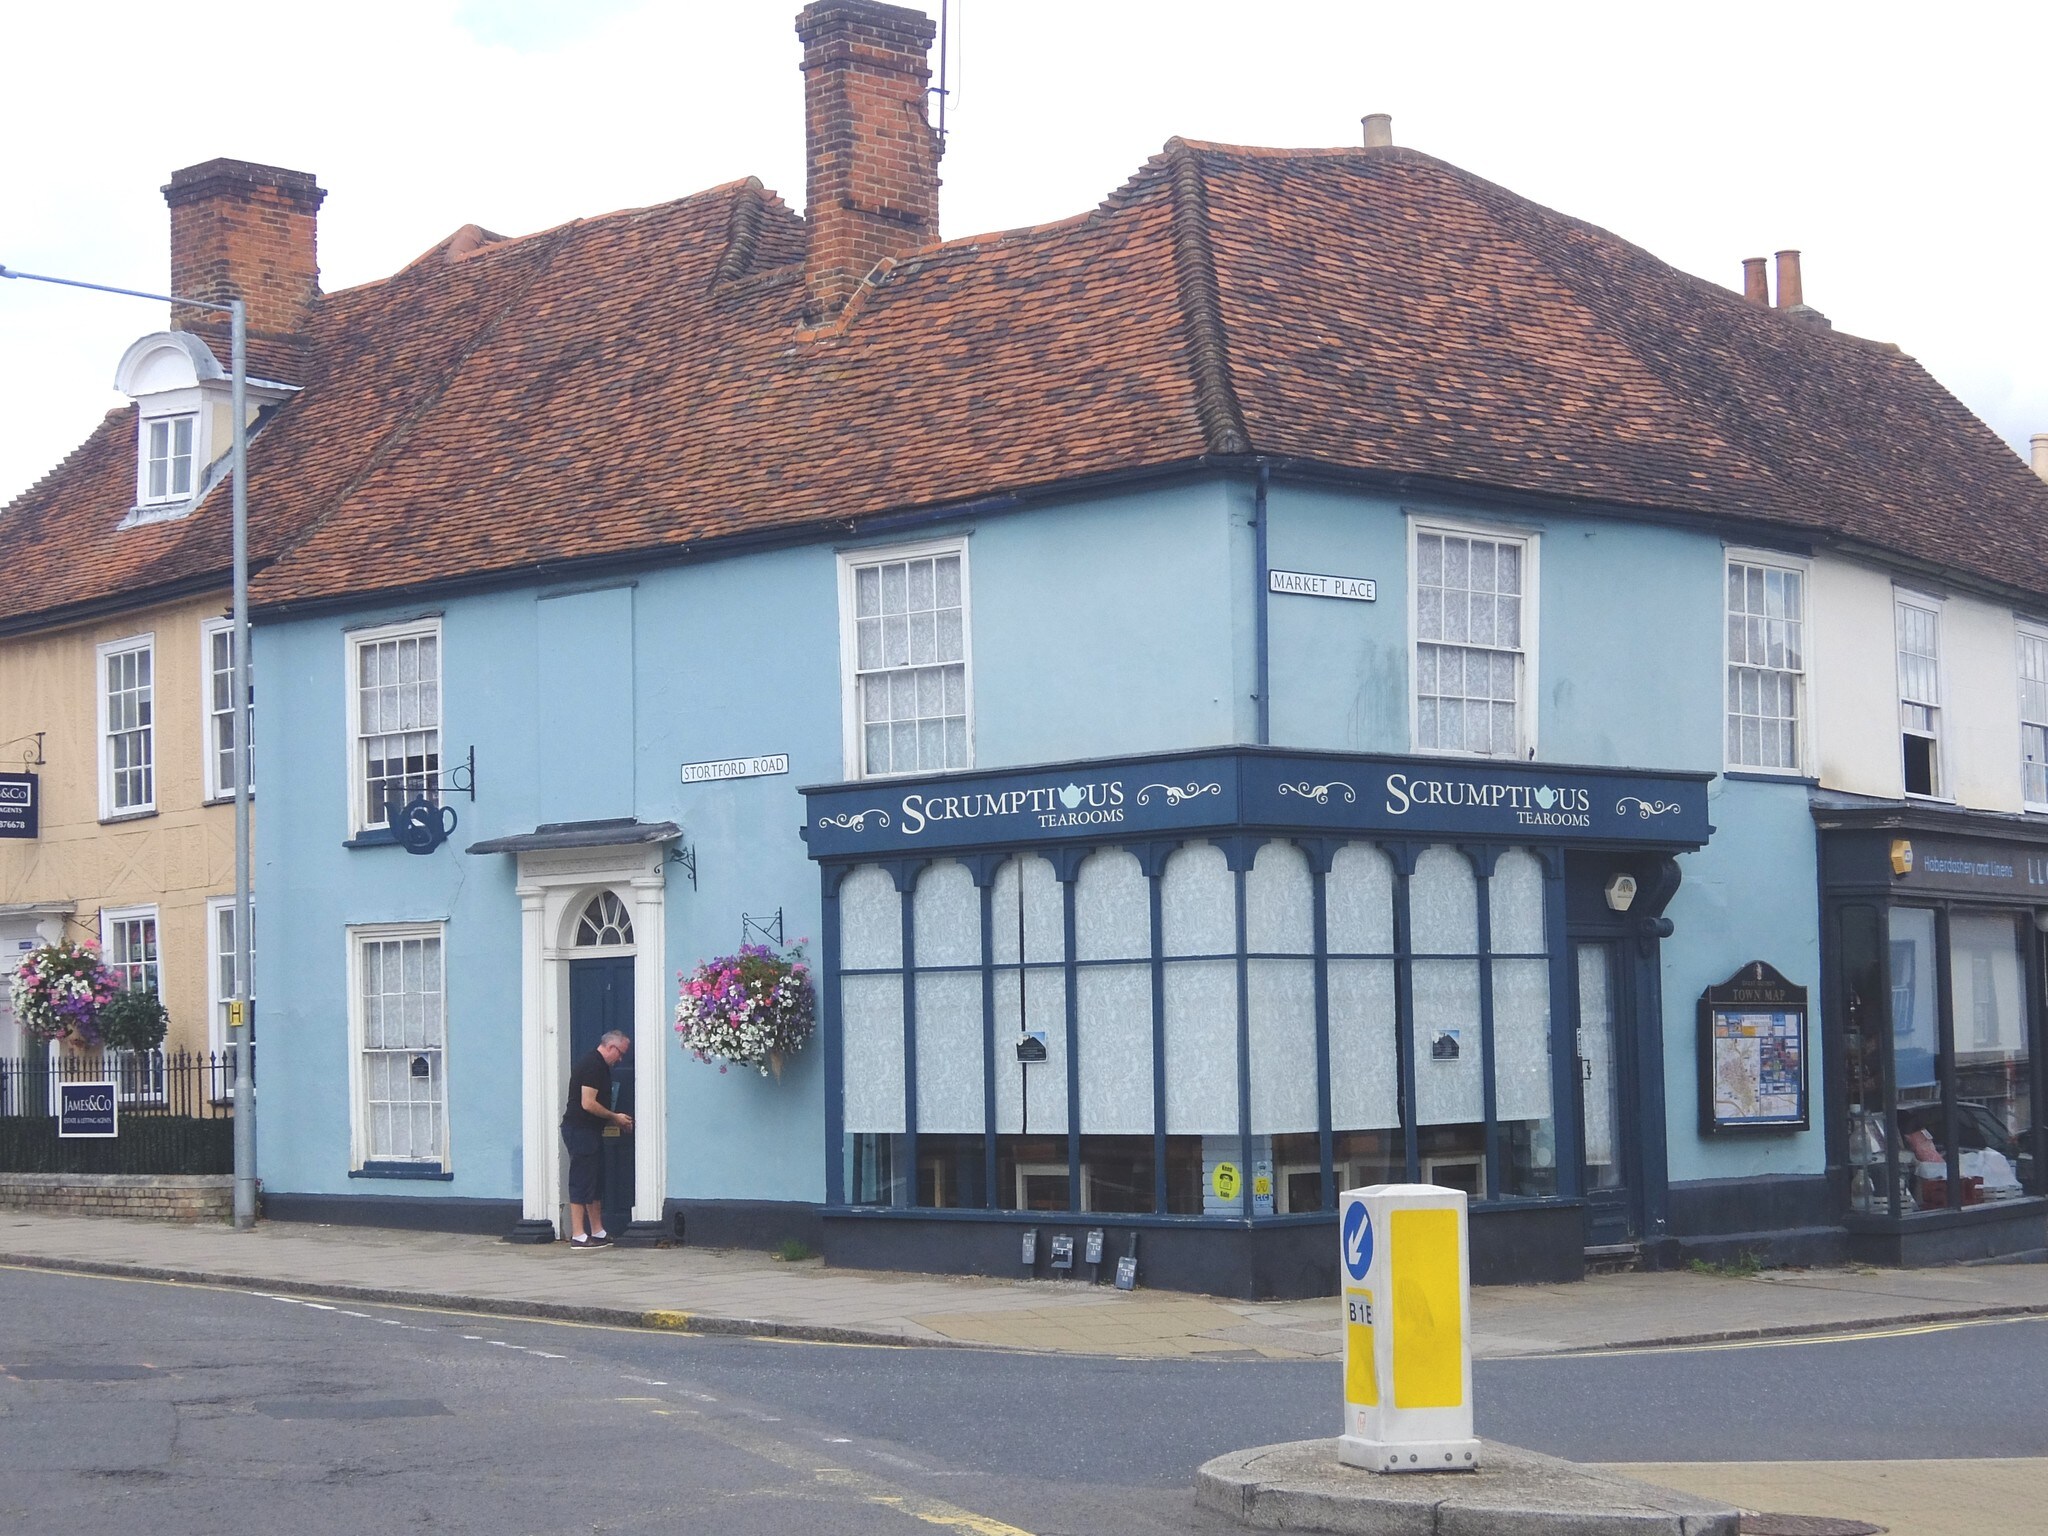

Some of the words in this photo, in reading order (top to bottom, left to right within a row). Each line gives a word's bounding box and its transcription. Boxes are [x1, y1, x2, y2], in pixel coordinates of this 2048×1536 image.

[1274, 574, 1327, 593] MARKET
[1335, 580, 1372, 598] PLACE
[684, 762, 746, 780] STORTFORD
[753, 758, 784, 773] ROAD
[1038, 808, 1124, 828] TEAROOMS
[1516, 811, 1590, 827] TEAROOMS
[1924, 856, 1975, 877] Haberdashery
[1976, 861, 1990, 875] and
[1990, 861, 2013, 878] Linens
[1733, 989, 1760, 1001] TOWN
[1764, 989, 1786, 1001] MAP
[231, 1003, 241, 1023] H
